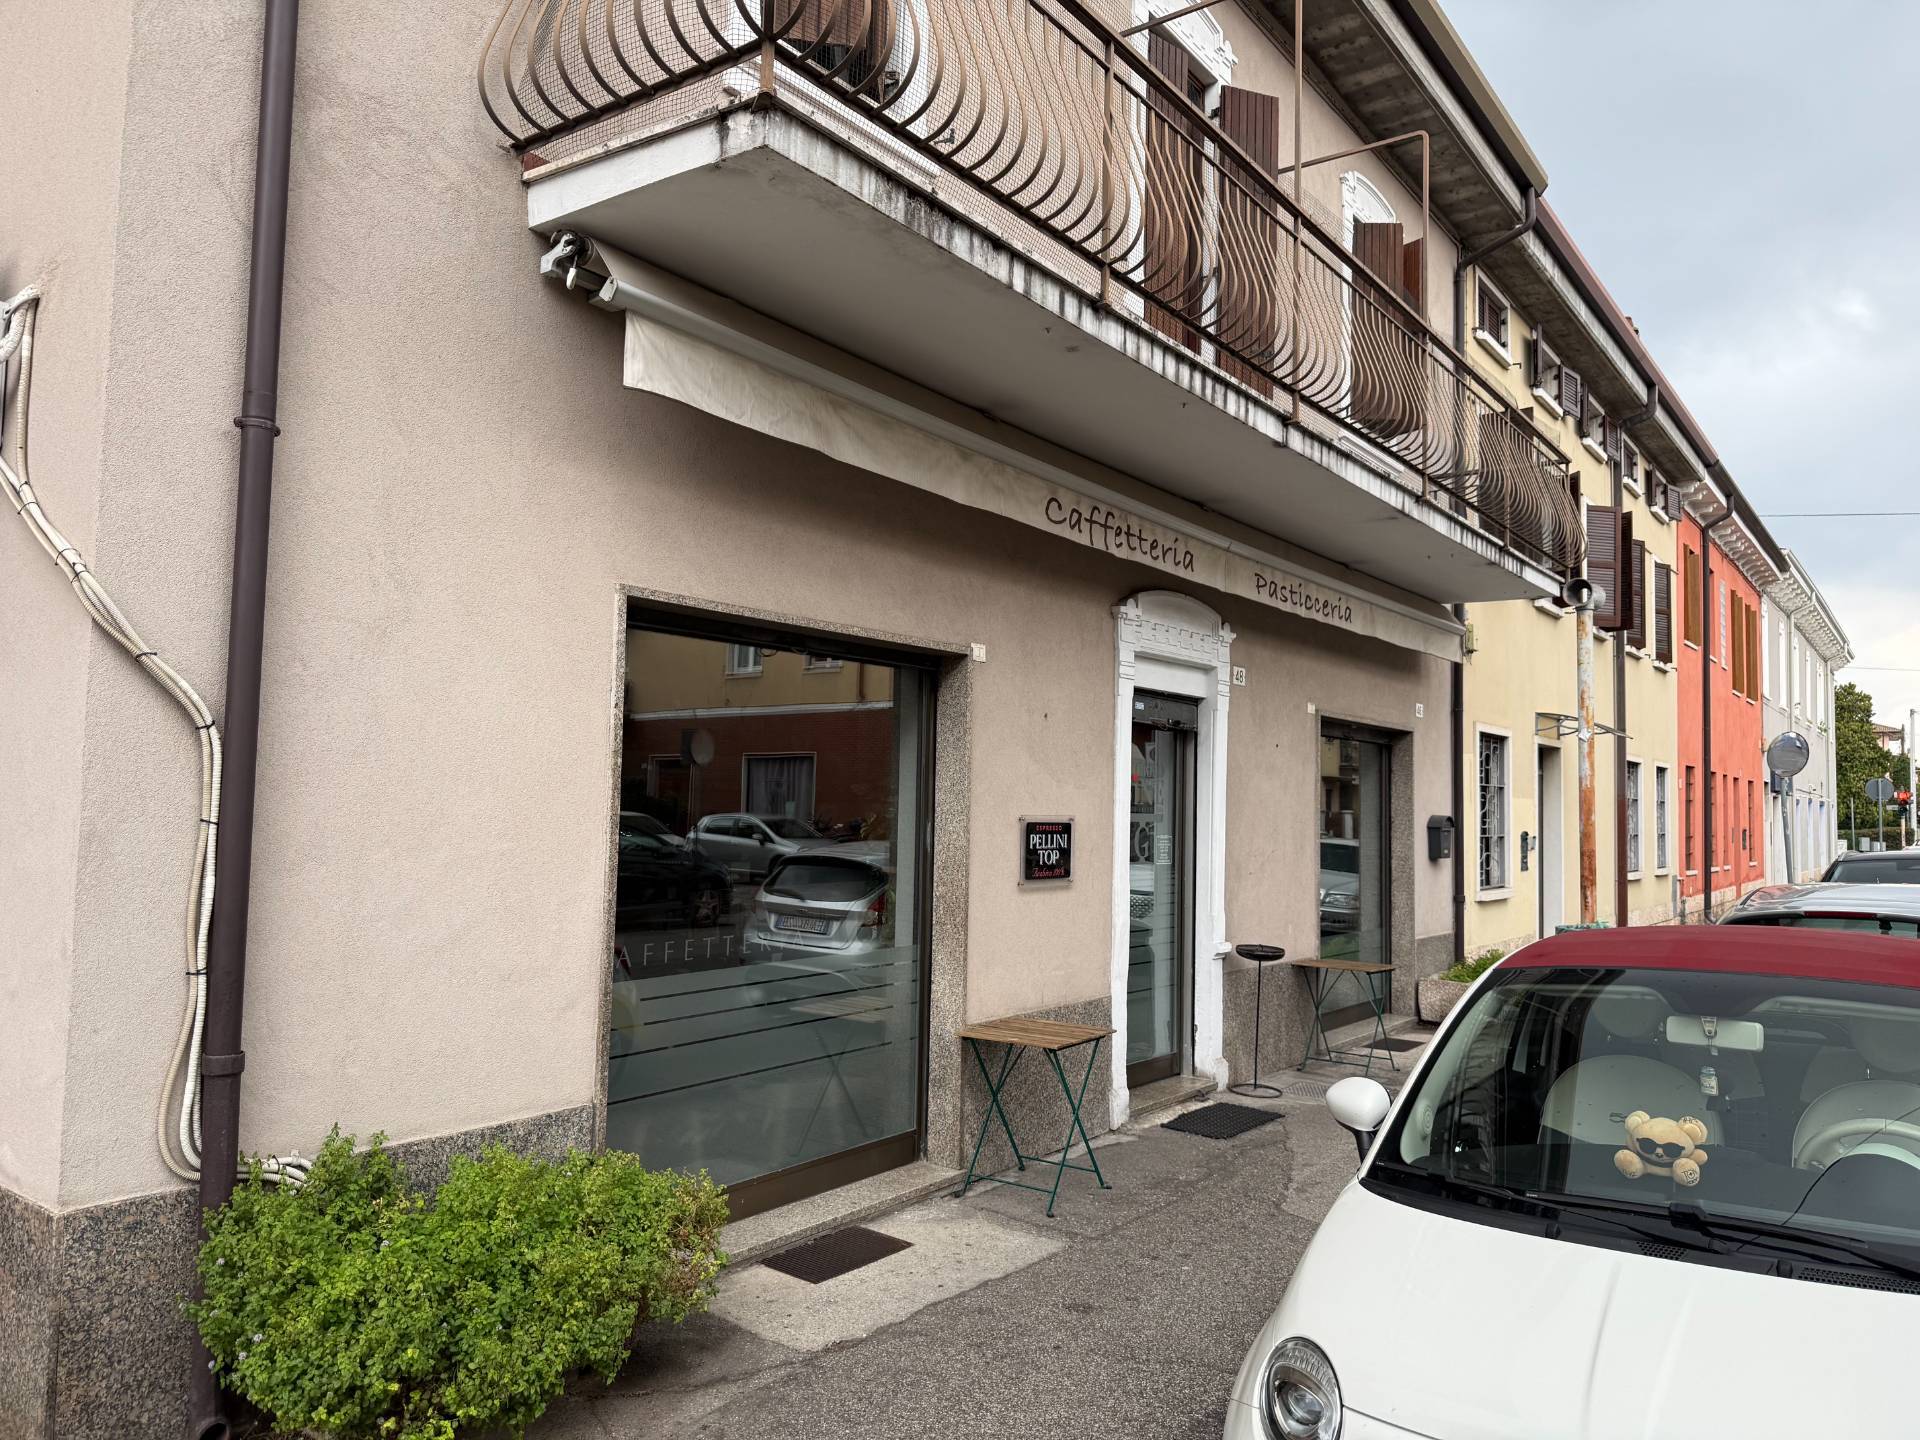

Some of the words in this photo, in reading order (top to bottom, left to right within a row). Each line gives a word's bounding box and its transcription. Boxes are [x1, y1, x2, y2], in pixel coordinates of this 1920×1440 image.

[1045, 497, 1195, 573] Caffetteria
[1254, 572, 1353, 624] Pasticceria
[1029, 833, 1068, 850] PELLINI
[1037, 849, 1060, 866] TOP
[615, 931, 805, 970] AFFETTERIA
